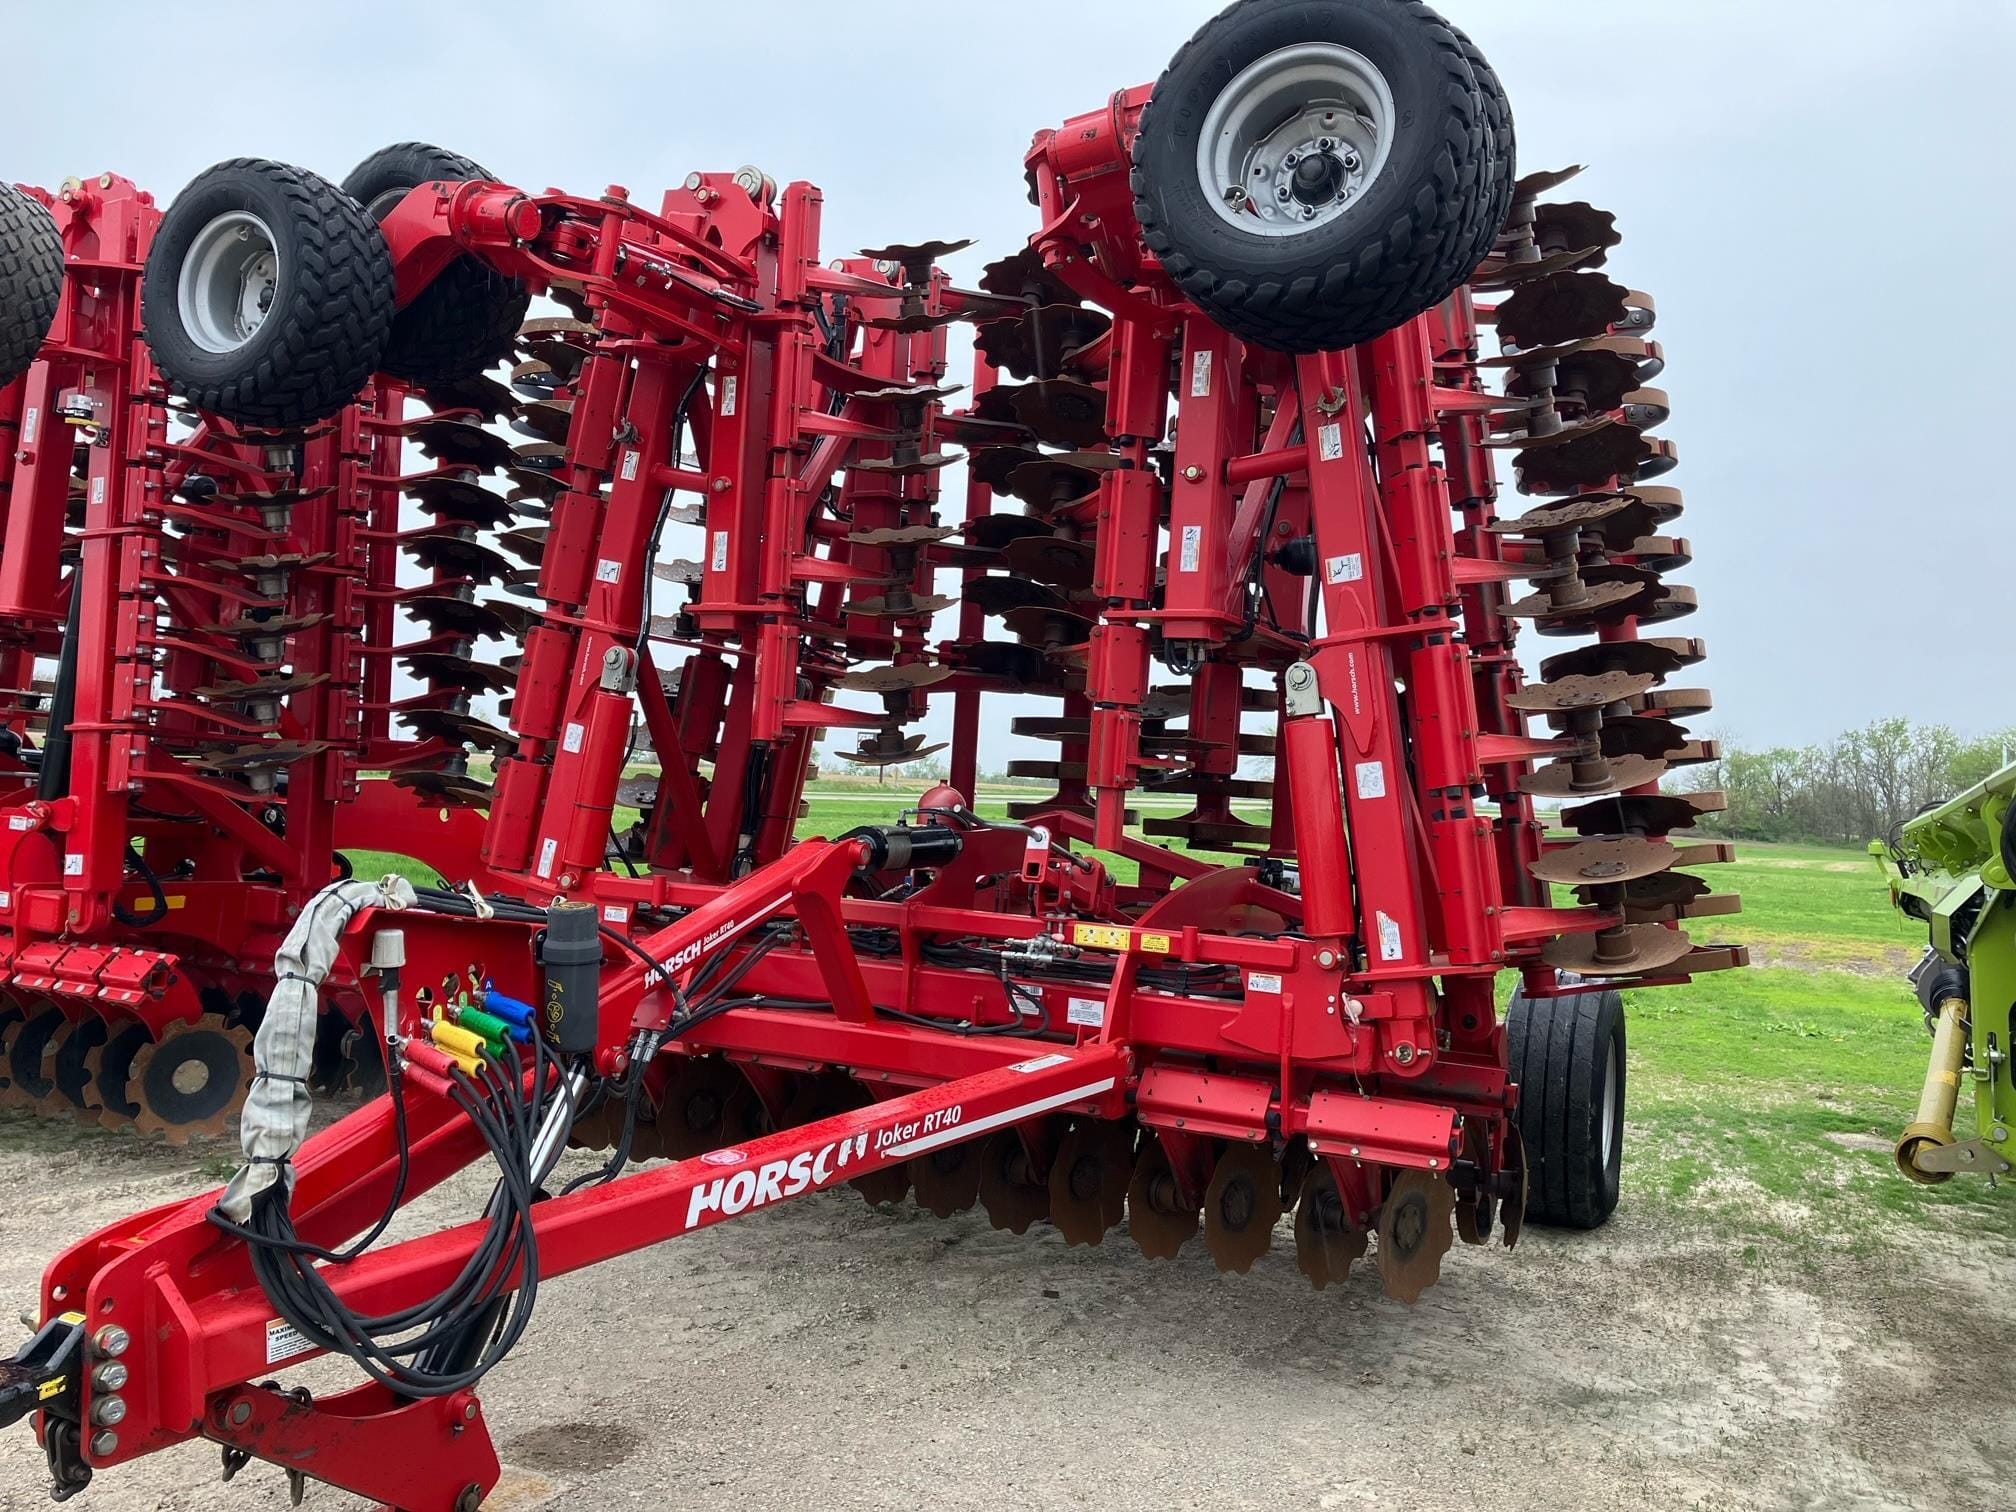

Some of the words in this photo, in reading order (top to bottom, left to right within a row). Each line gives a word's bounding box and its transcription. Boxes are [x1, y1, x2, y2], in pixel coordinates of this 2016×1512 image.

[1348, 652, 1361, 715] www.horsch.com
[703, 929, 719, 946] Joker
[719, 919, 735, 935] RT40
[874, 1120, 921, 1150] Joker
[923, 1104, 963, 1134] RT40
[275, 1330, 298, 1342] SPEED
